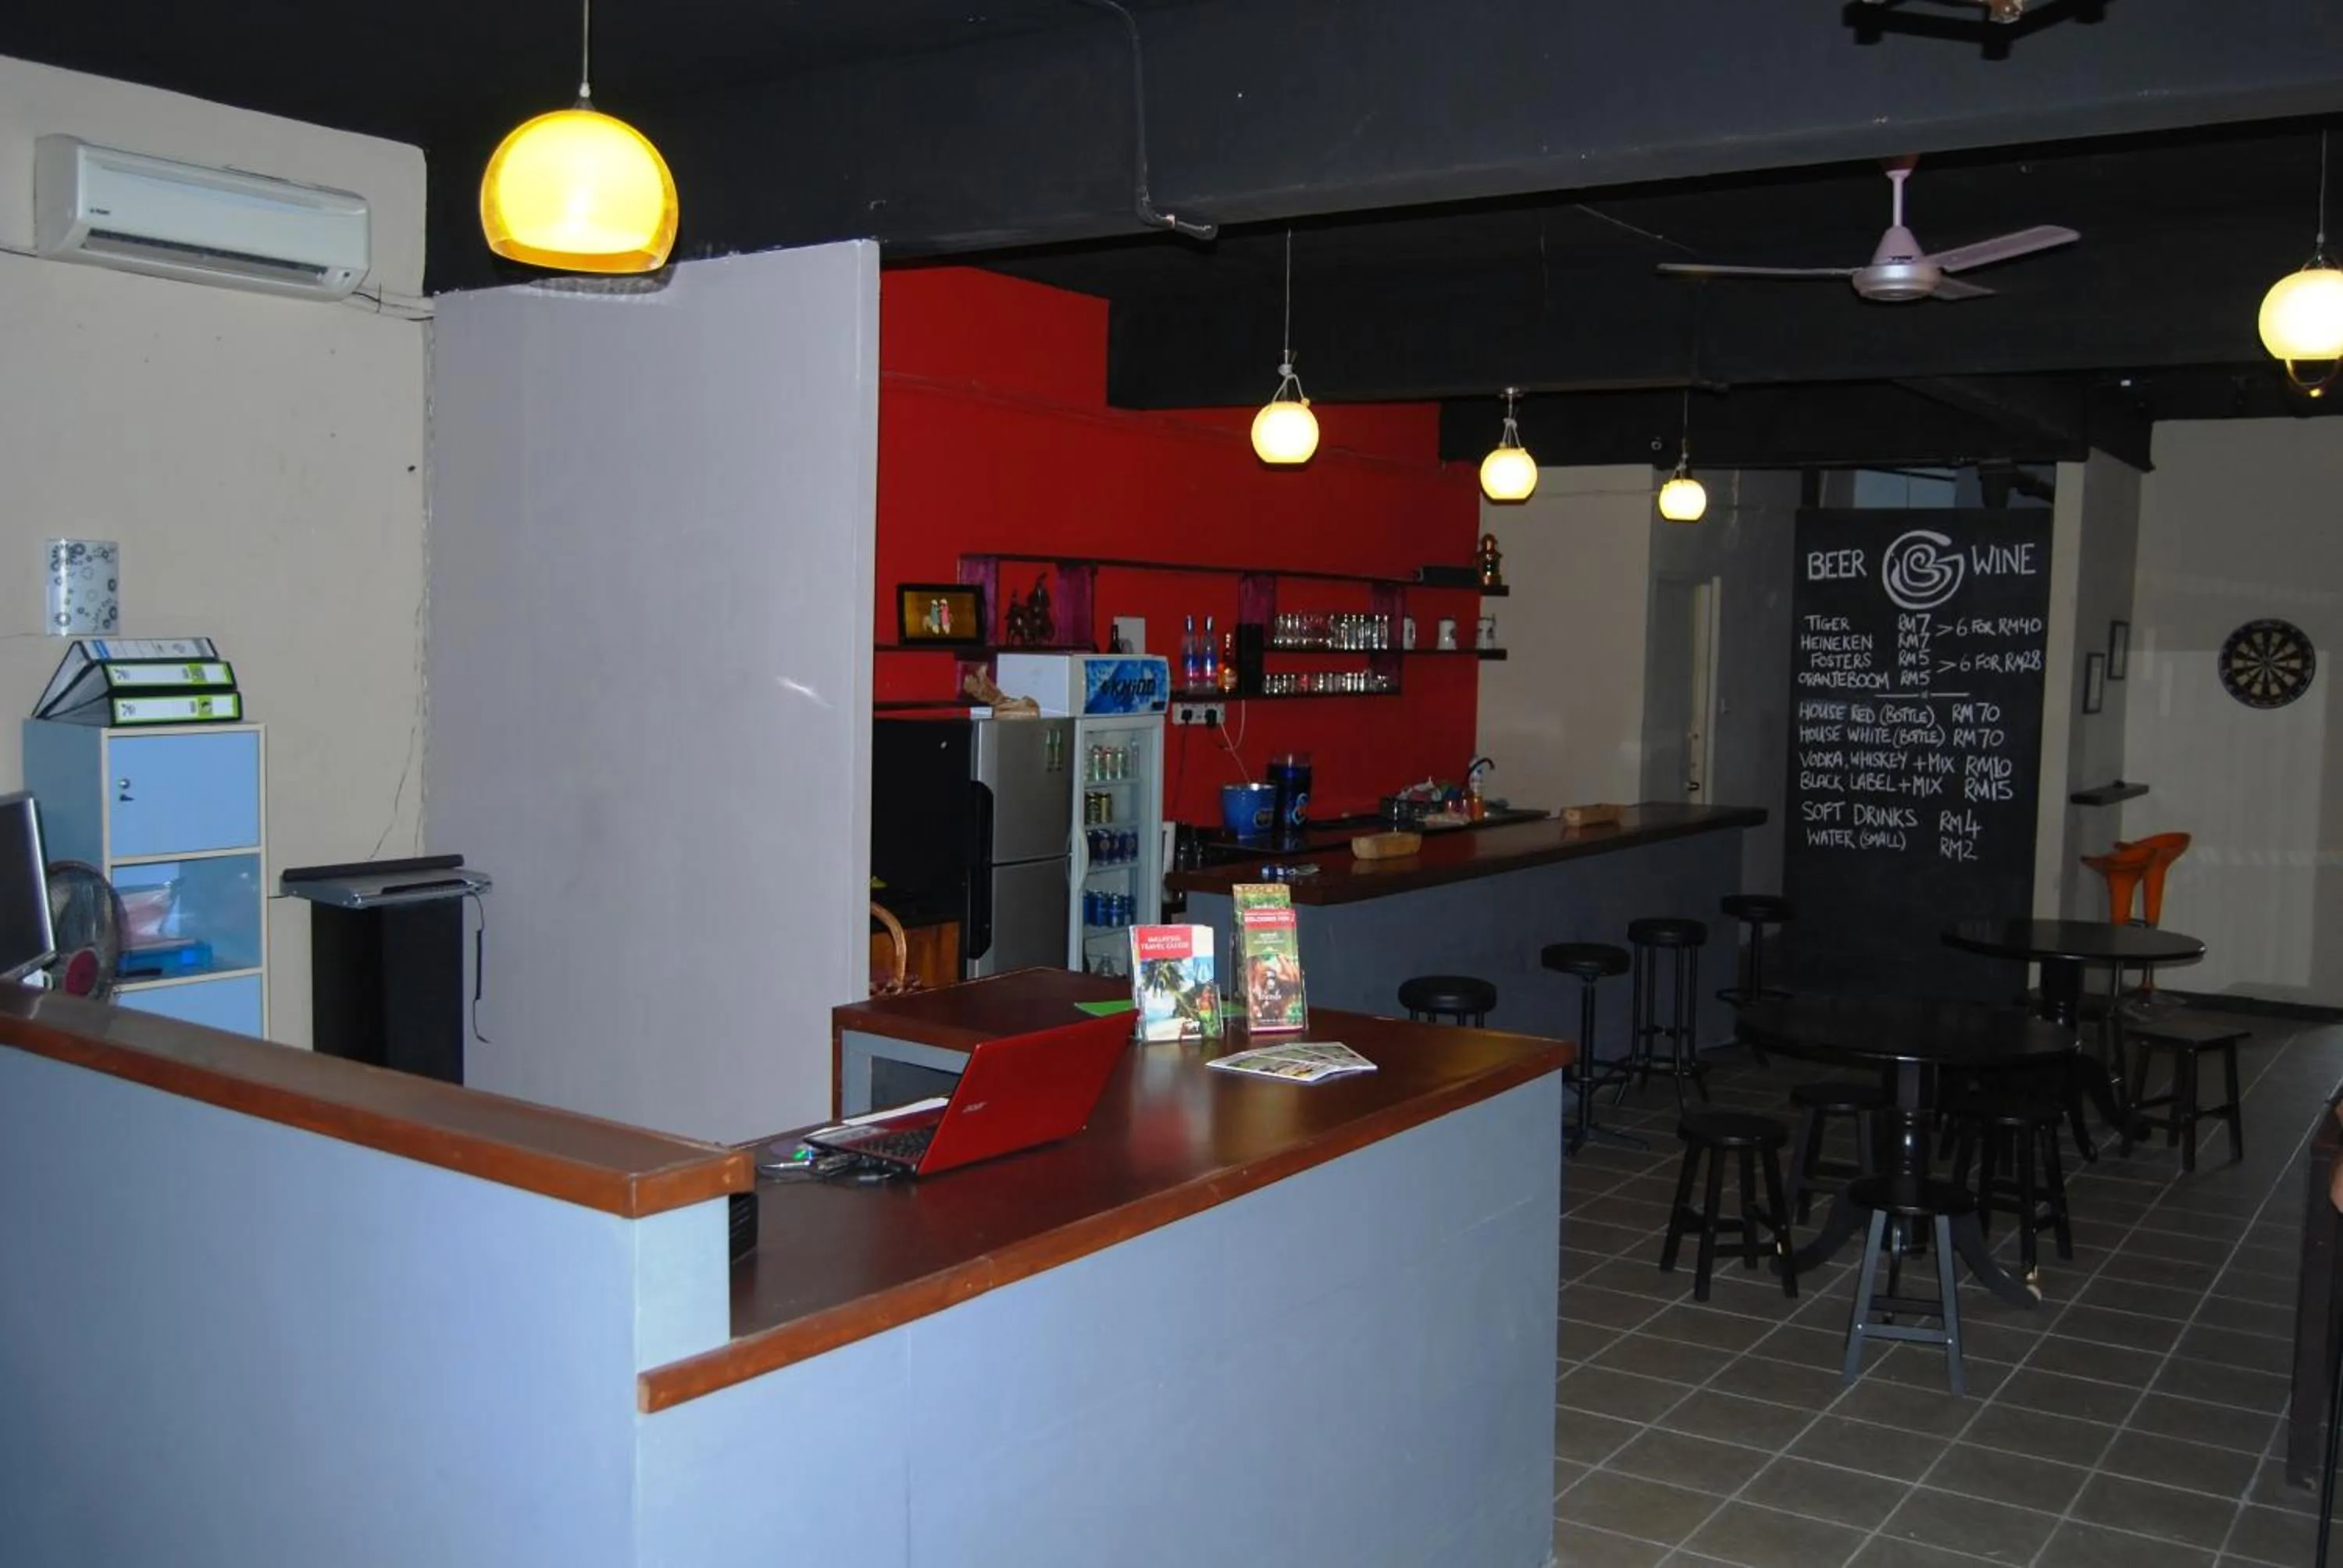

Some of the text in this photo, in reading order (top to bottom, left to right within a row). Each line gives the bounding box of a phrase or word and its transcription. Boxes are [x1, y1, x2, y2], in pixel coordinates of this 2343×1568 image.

[1807, 549, 1867, 580] BEER
[1971, 543, 2037, 576] WINE
[1804, 613, 1931, 634] TIGER RM7
[1956, 618, 2042, 636] 6 FOR RM40
[1800, 632, 1931, 650] HEINEKEN RM7
[1811, 649, 1931, 669] FOSTERS RM5
[1959, 648, 2042, 673] 6 FOR RM28
[1798, 669, 1931, 690] ORANJEBOOM RM5
[1799, 701, 1847, 721] HOUSE
[1850, 704, 1875, 724] RED
[1799, 724, 1842, 744] HOUSE
[1846, 725, 1892, 744] WHITE
[1849, 750, 1908, 771] WHISKEY
[1965, 755, 2013, 781] RM10
[1799, 770, 1845, 793] BLACK
[1849, 772, 1896, 792] LABEL
[1964, 776, 2014, 803] RM15
[1801, 800, 1846, 821] SOFT
[1853, 803, 1919, 828] DRINKS
[1806, 828, 1856, 849] WATER
[1939, 836, 1978, 862] RM2
